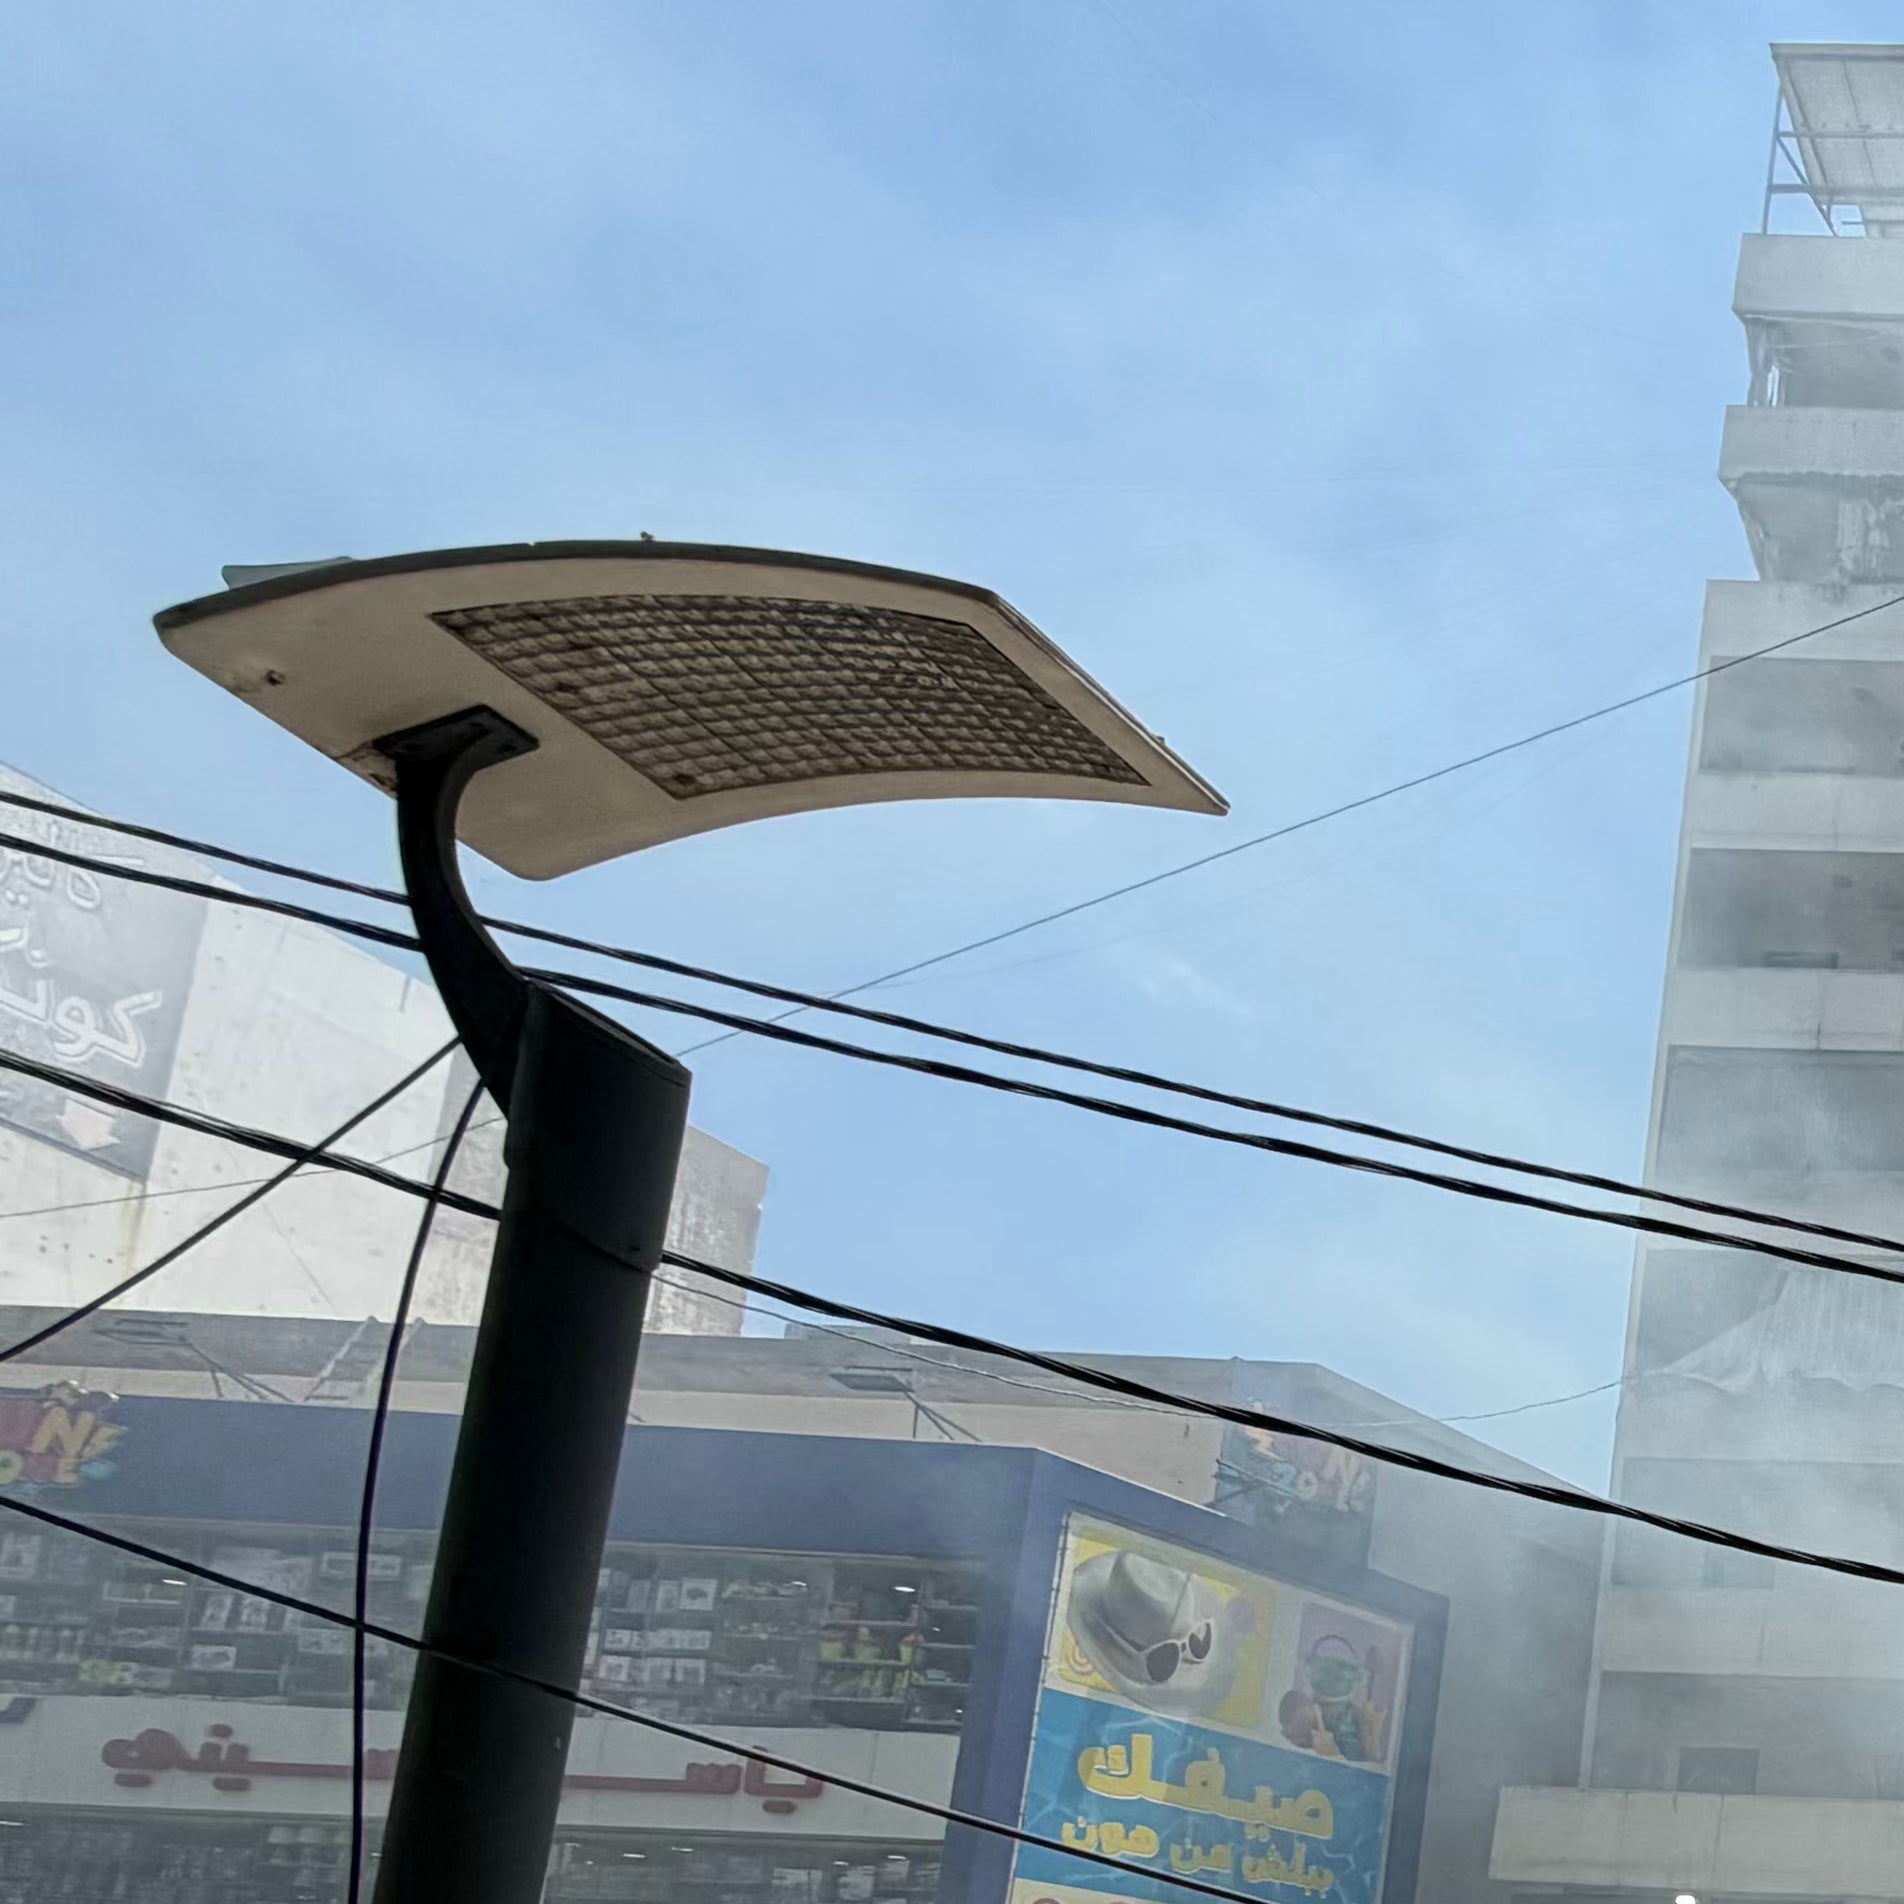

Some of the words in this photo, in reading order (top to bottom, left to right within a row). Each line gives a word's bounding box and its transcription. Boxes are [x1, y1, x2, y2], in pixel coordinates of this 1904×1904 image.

[1077, 1734, 1333, 1842] صيفك
[1062, 1816, 1159, 1858] هون
[1170, 1837, 1231, 1874] من
